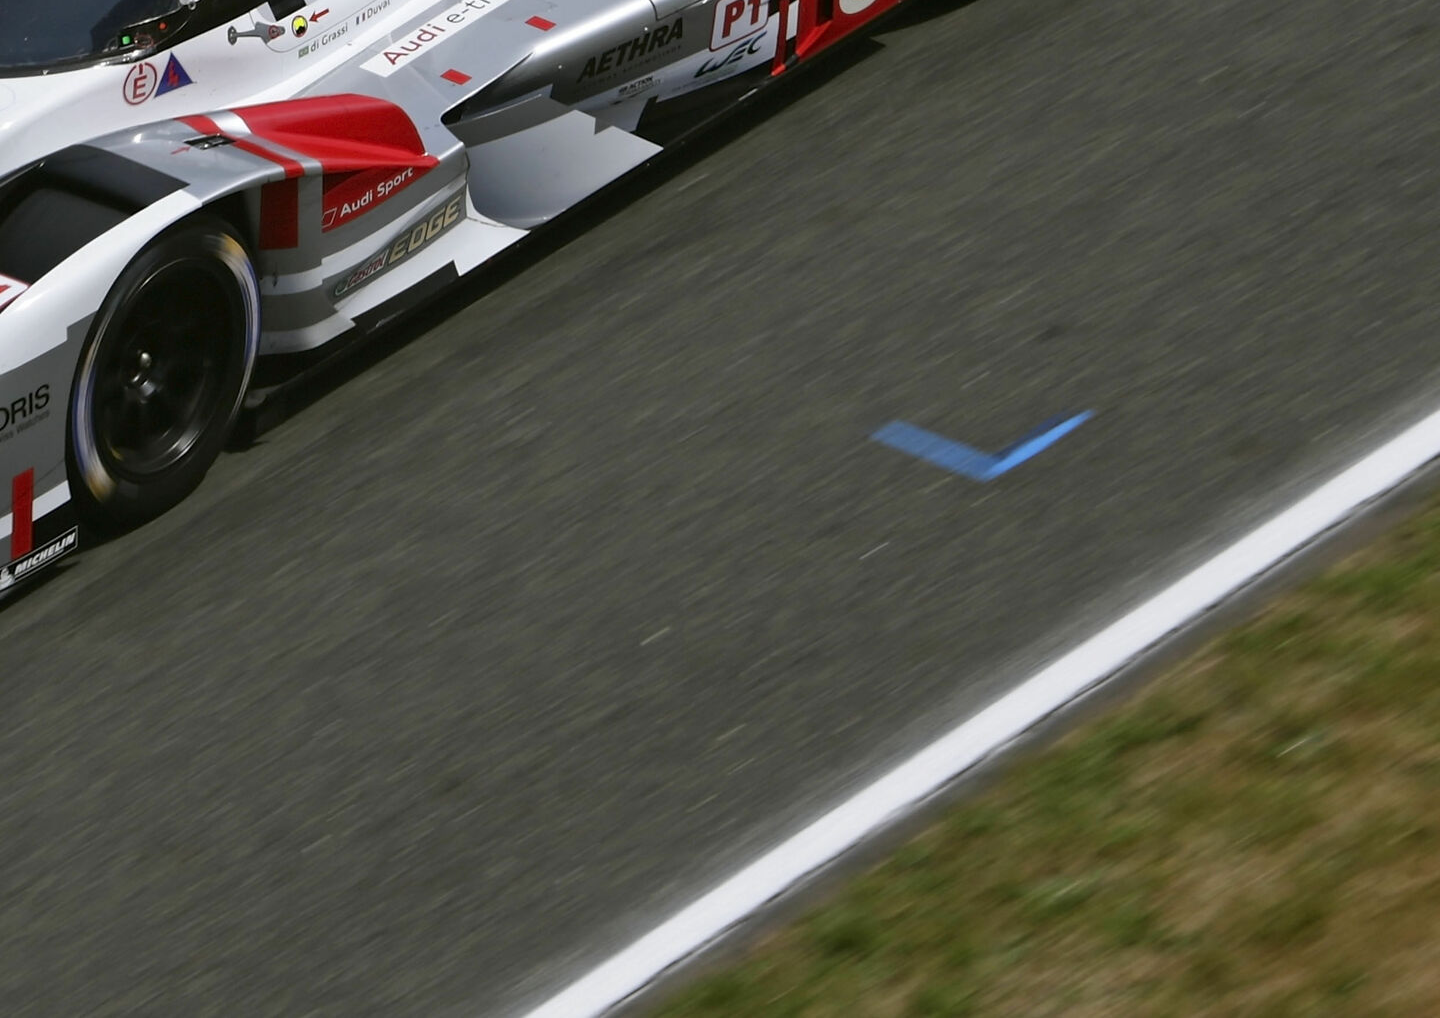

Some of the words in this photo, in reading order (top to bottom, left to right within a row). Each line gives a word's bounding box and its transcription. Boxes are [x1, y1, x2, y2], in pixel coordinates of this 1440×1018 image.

[310, 41, 319, 53] di
[321, 23, 348, 46] Grassi
[383, 23, 446, 66] Audi
[576, 17, 684, 83] AETHRA
[694, 31, 768, 78] WEC
[340, 190, 373, 218] Audi
[377, 167, 414, 197] Sport
[388, 196, 461, 264] EDGE
[14, 532, 76, 575] MICHELIN
